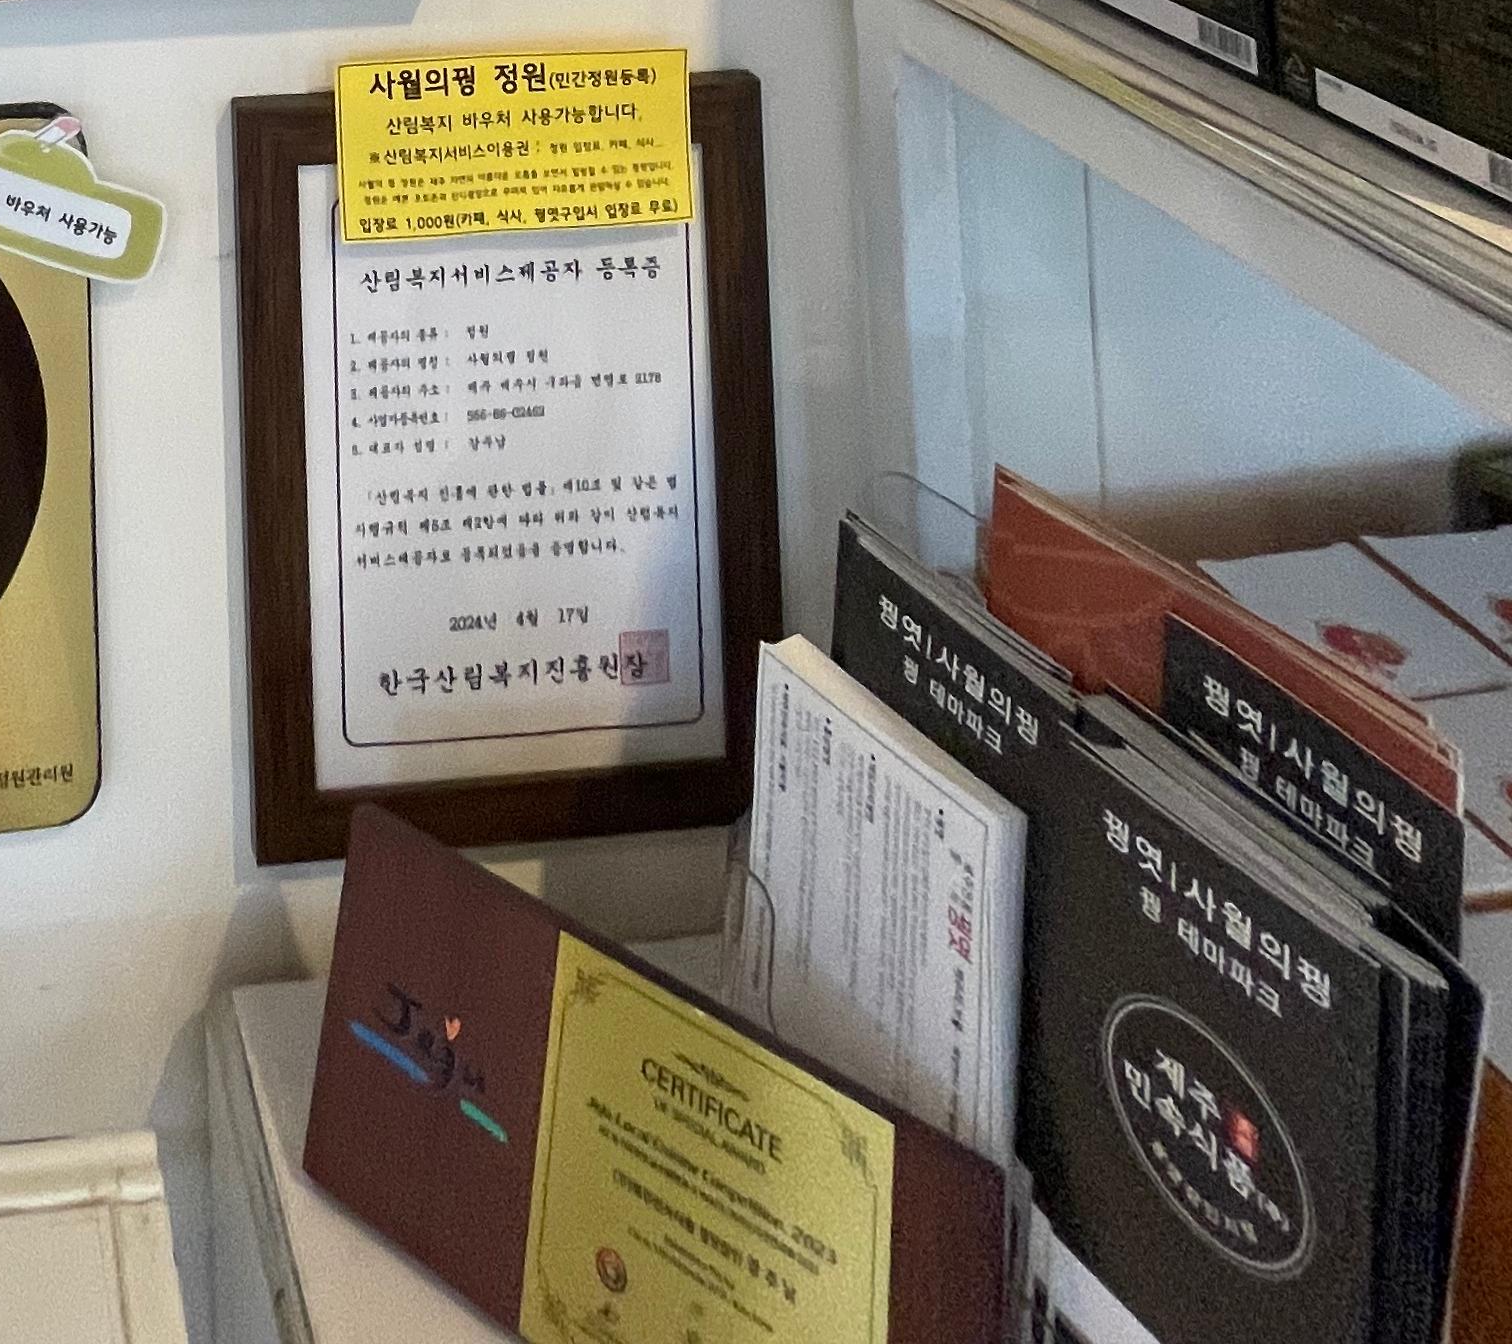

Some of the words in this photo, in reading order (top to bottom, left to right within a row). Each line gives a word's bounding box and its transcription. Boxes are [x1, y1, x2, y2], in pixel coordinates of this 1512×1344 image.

[369, 64, 476, 101] 사월의꿩
[387, 113, 453, 137] 산림복지
[462, 110, 511, 130] 바우처
[5, 193, 52, 223] 바우처
[58, 211, 118, 246] 사용가능
[359, 217, 397, 234] 입장료
[605, 201, 642, 219] 입장료
[360, 258, 583, 294] 산림복지서비스제공자
[596, 255, 661, 281] 등록증
[928, 678, 1004, 755] 테마파크
[1275, 774, 1376, 868] 테마파크
[1177, 916, 1283, 1018] 테마파크
[640, 1057, 783, 1164] CERTIFICATE
